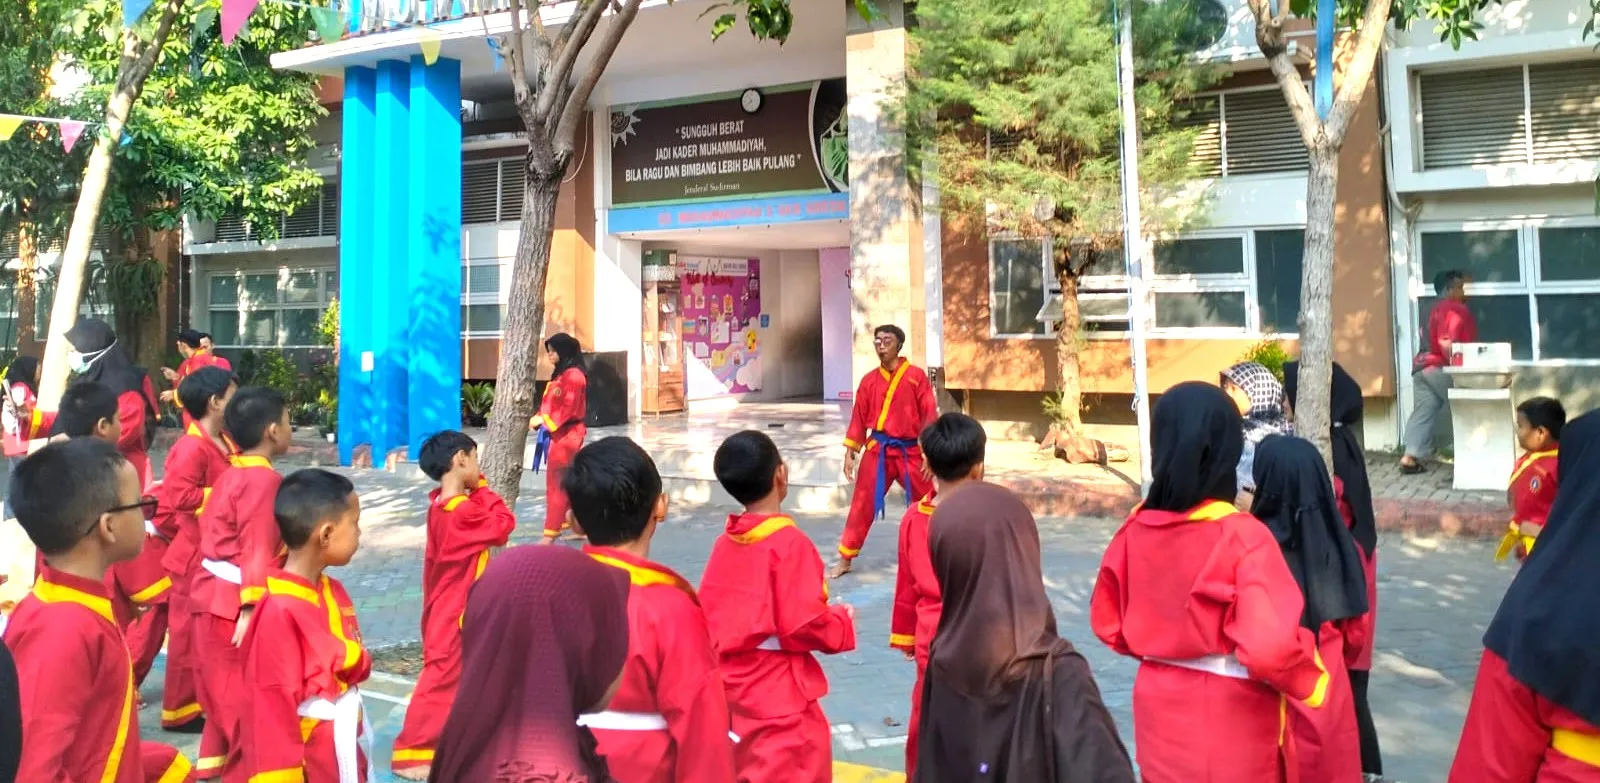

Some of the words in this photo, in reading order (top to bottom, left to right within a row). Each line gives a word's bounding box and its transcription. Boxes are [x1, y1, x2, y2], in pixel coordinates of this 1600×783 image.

[681, 125, 718, 140] SUNGGUH
[719, 120, 745, 137] BERAT
[655, 147, 671, 161] JADI
[672, 144, 698, 159] KADER
[699, 137, 767, 157] MUHAMMADIYAH,
[625, 169, 642, 182] BILA
[643, 166, 663, 180] RAGU
[664, 165, 680, 179] DAN
[681, 162, 717, 178] BIMBANG
[718, 159, 742, 174] LEBIH
[742, 157, 762, 172] BAIK
[763, 154, 795, 171] PULANG
